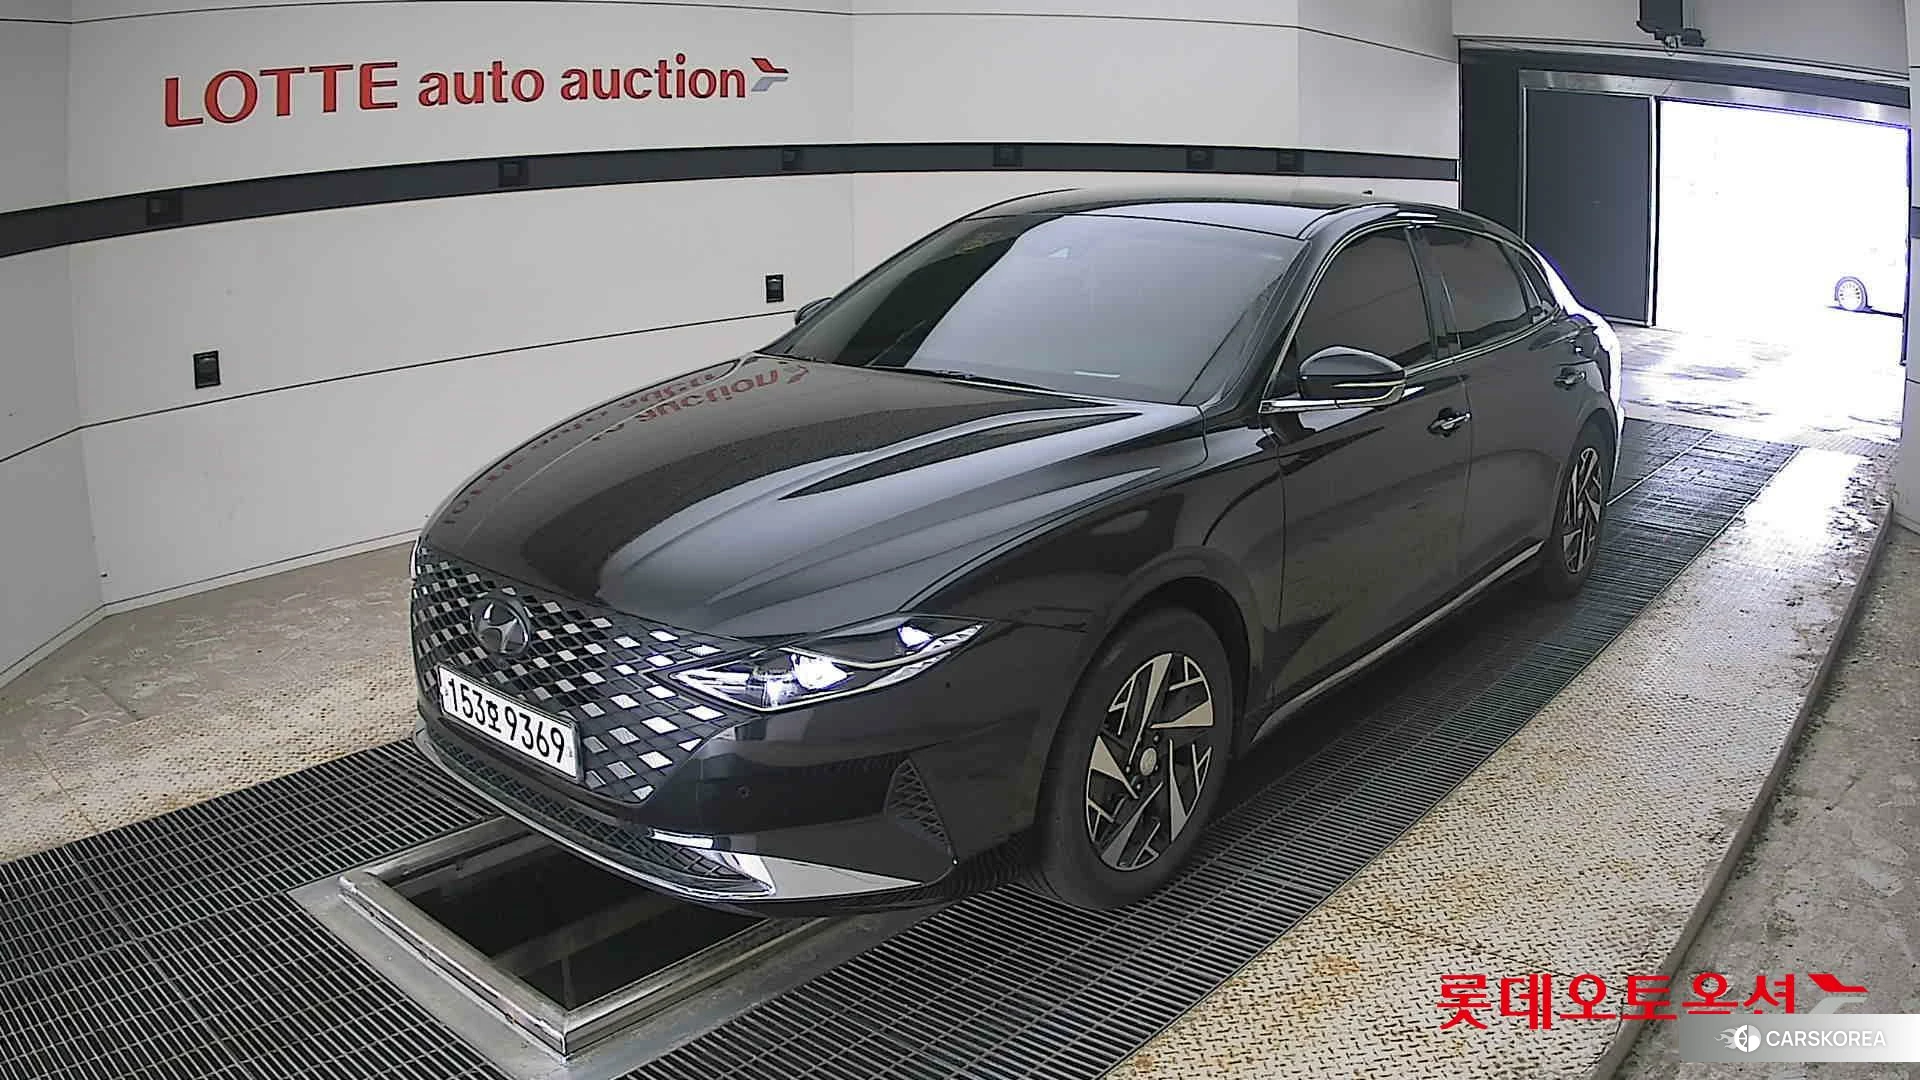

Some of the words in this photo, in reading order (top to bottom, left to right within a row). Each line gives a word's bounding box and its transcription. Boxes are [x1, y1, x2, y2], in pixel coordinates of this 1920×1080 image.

[165, 62, 399, 127] LOTTE
[418, 60, 545, 107] auto
[560, 53, 747, 101] auction
